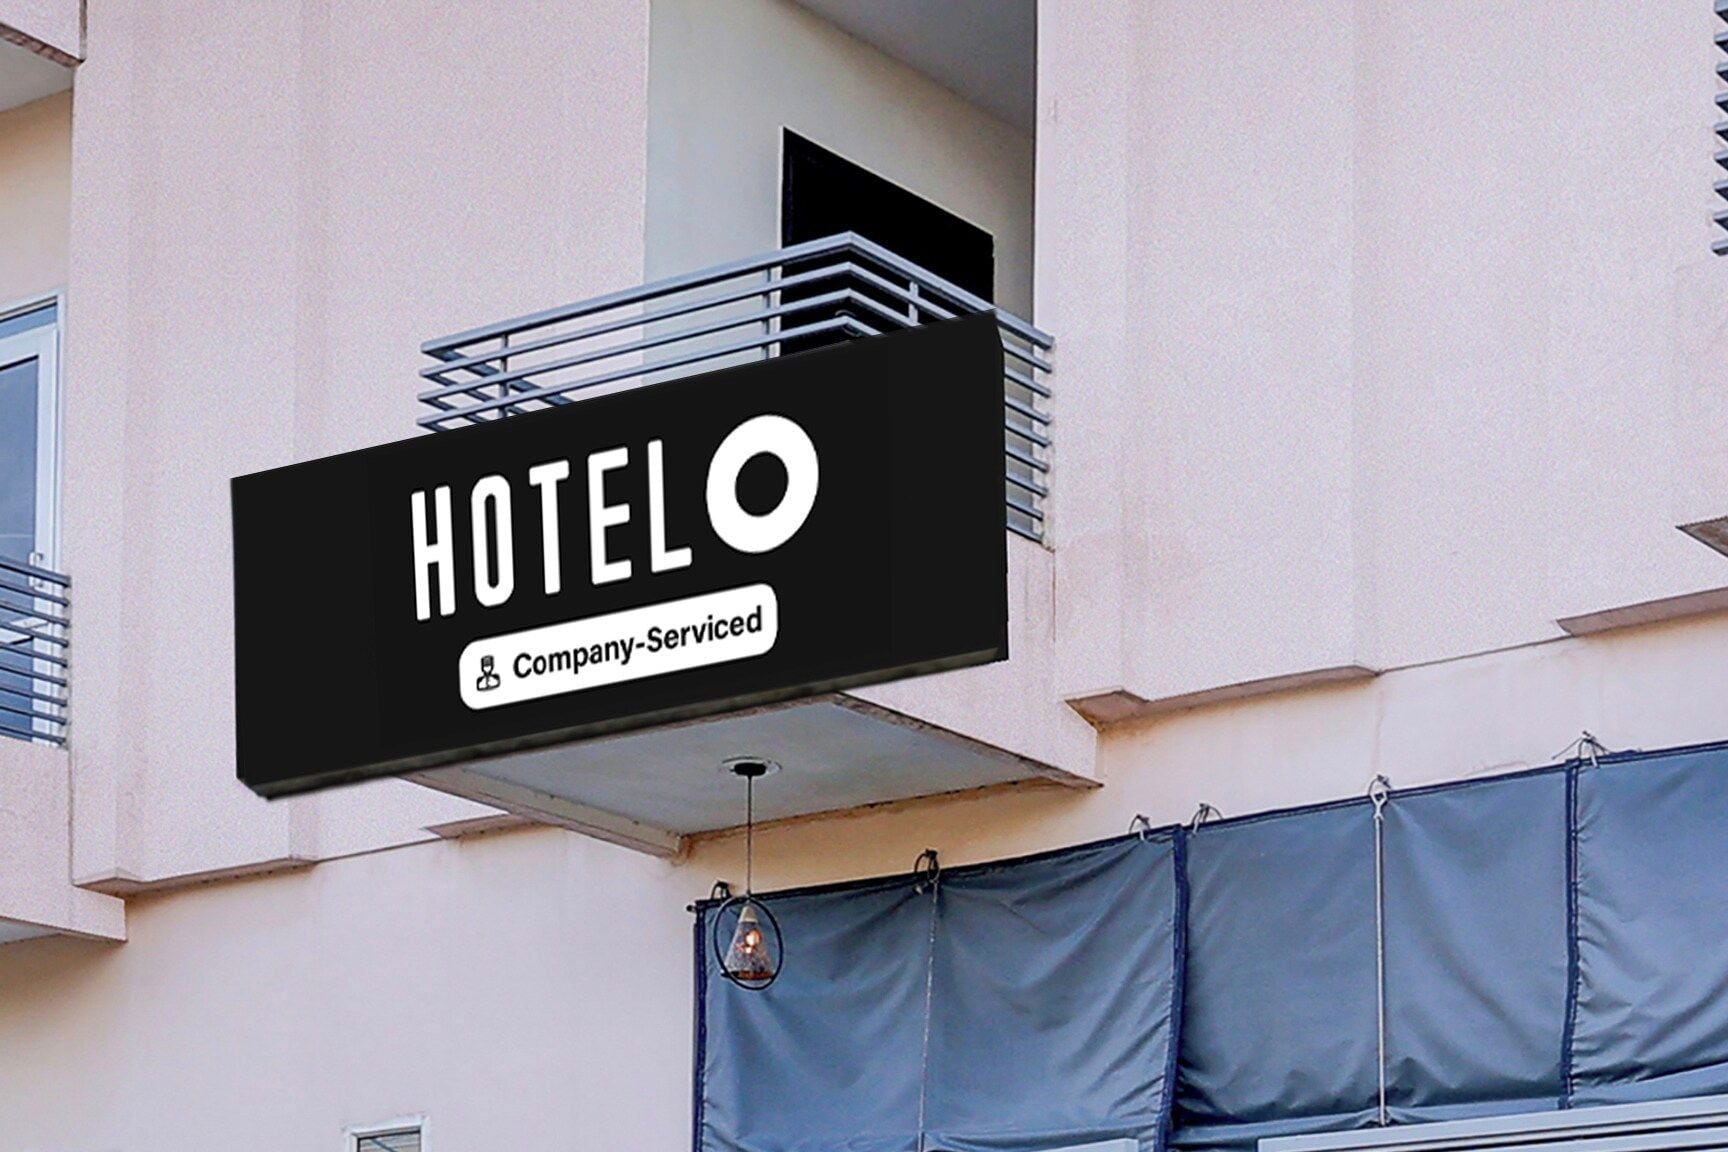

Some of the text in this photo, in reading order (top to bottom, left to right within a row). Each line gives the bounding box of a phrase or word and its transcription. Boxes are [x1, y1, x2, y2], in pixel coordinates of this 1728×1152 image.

[411, 414, 819, 621] HOTEL O
[512, 604, 763, 680] Company-Serviced
